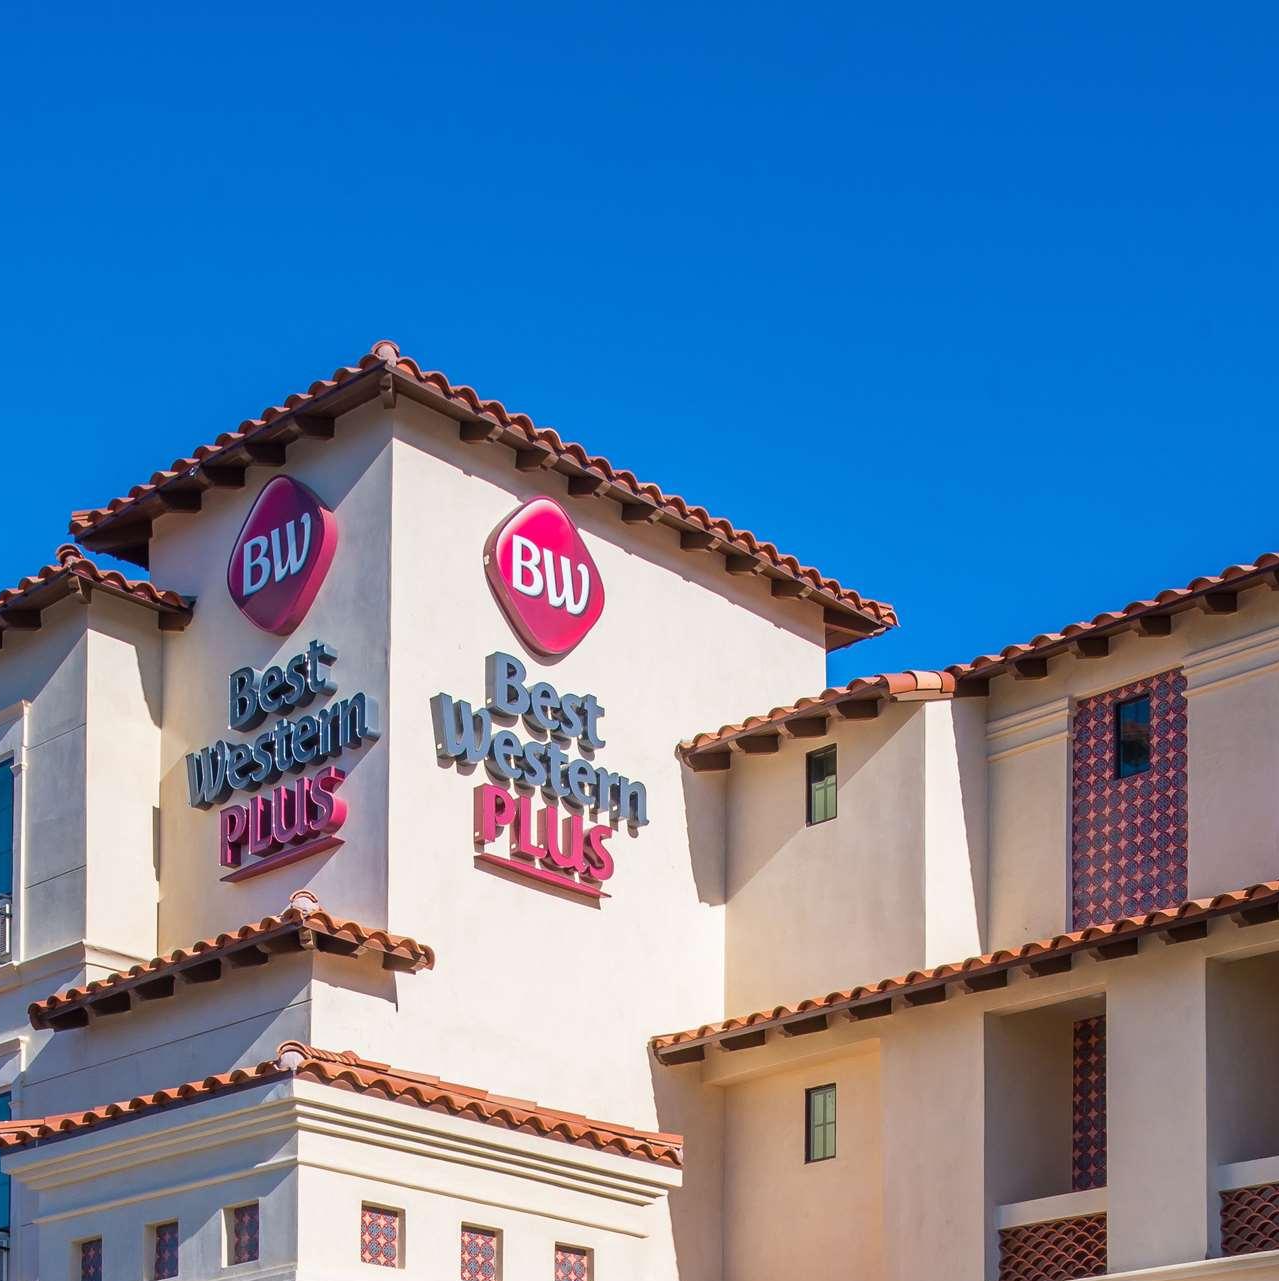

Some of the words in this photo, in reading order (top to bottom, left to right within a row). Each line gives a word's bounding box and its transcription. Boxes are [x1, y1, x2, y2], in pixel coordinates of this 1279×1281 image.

[242, 512, 312, 598] BW
[512, 534, 589, 615] BW
[228, 639, 338, 732] Best
[485, 651, 606, 750] Best
[185, 691, 380, 809] Western
[430, 692, 649, 827] Western
[220, 766, 348, 867] PLUS
[474, 783, 615, 880] PLUS
